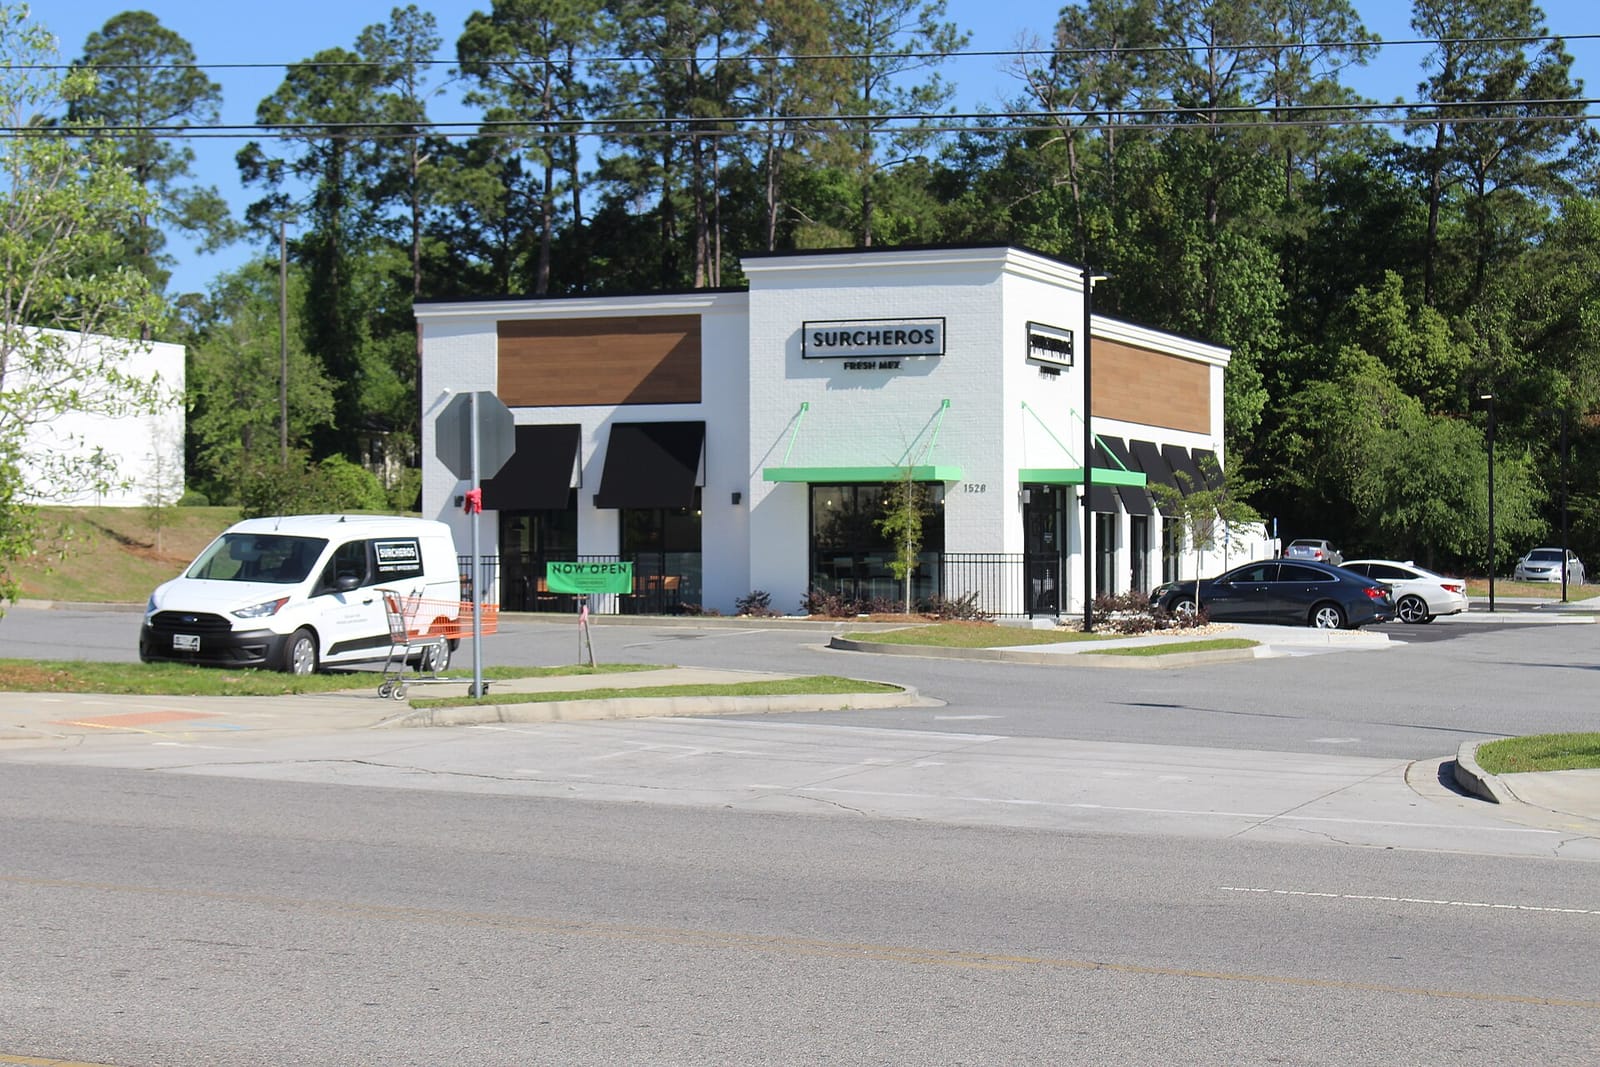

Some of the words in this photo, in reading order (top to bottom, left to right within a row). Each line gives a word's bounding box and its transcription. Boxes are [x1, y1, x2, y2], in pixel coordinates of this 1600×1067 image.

[813, 328, 935, 347] SURCHEROS
[844, 361, 876, 370] FRESH
[964, 483, 986, 493] 1528
[552, 564, 584, 575] NOW
[590, 564, 627, 574] OPEN
